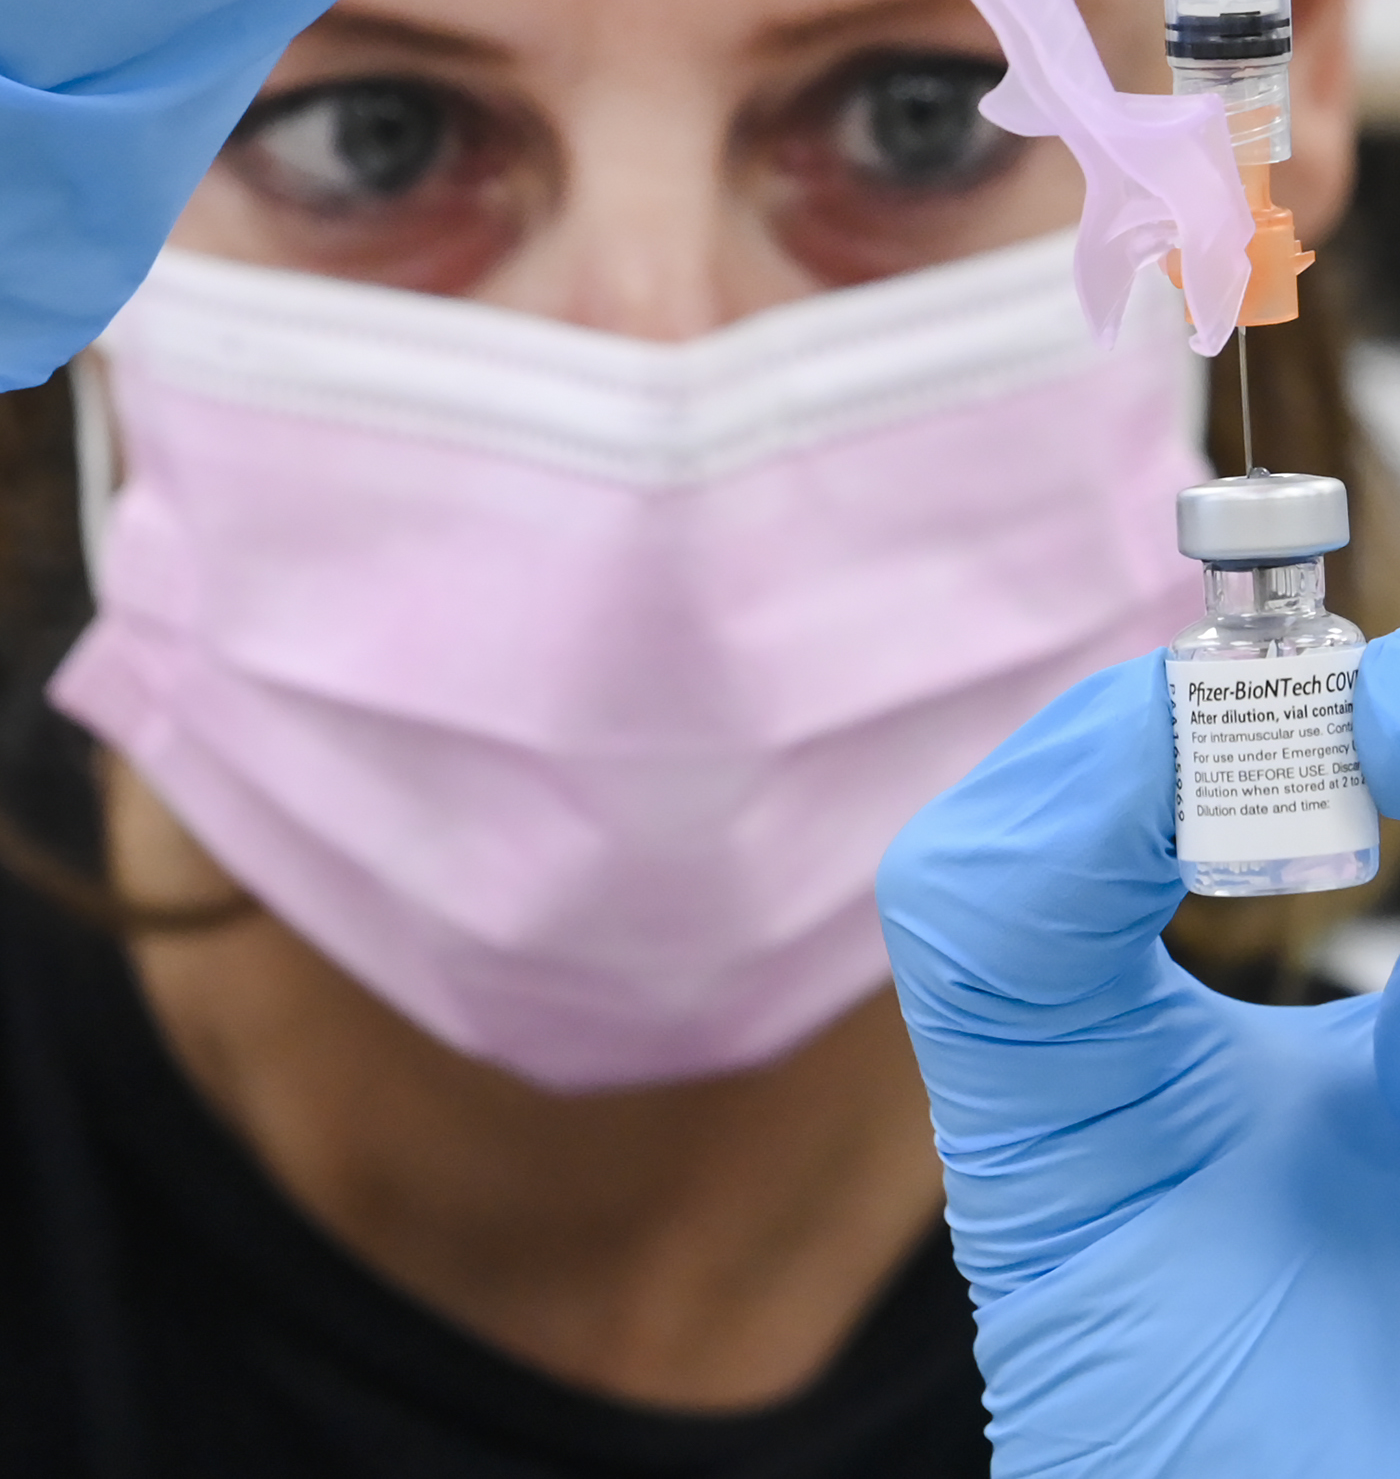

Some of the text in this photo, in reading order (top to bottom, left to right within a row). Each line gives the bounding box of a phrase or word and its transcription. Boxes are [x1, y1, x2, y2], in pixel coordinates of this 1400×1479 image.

[1188, 674, 1322, 707] Pfizer-BioNTech
[1190, 710, 1218, 725] After
[1221, 707, 1280, 724] dilution,
[1283, 704, 1308, 720] vial
[1191, 731, 1208, 743] For
[1210, 728, 1295, 743] intramuscular
[1299, 727, 1323, 738] use.
[1193, 751, 1209, 763] For
[1213, 753, 1234, 763] use
[1237, 749, 1278, 762] under
[1282, 743, 1350, 759] Emergency
[1194, 770, 1234, 783] DILUTE
[1238, 767, 1295, 783] BEFORE
[1195, 786, 1238, 798] dilution
[1241, 785, 1280, 797] when
[1284, 779, 1325, 794] stored
[1329, 778, 1340, 789] at
[1342, 775, 1348, 788] 2
[1350, 775, 1359, 787] to
[1196, 799, 1330, 817] Dilution date and time:
